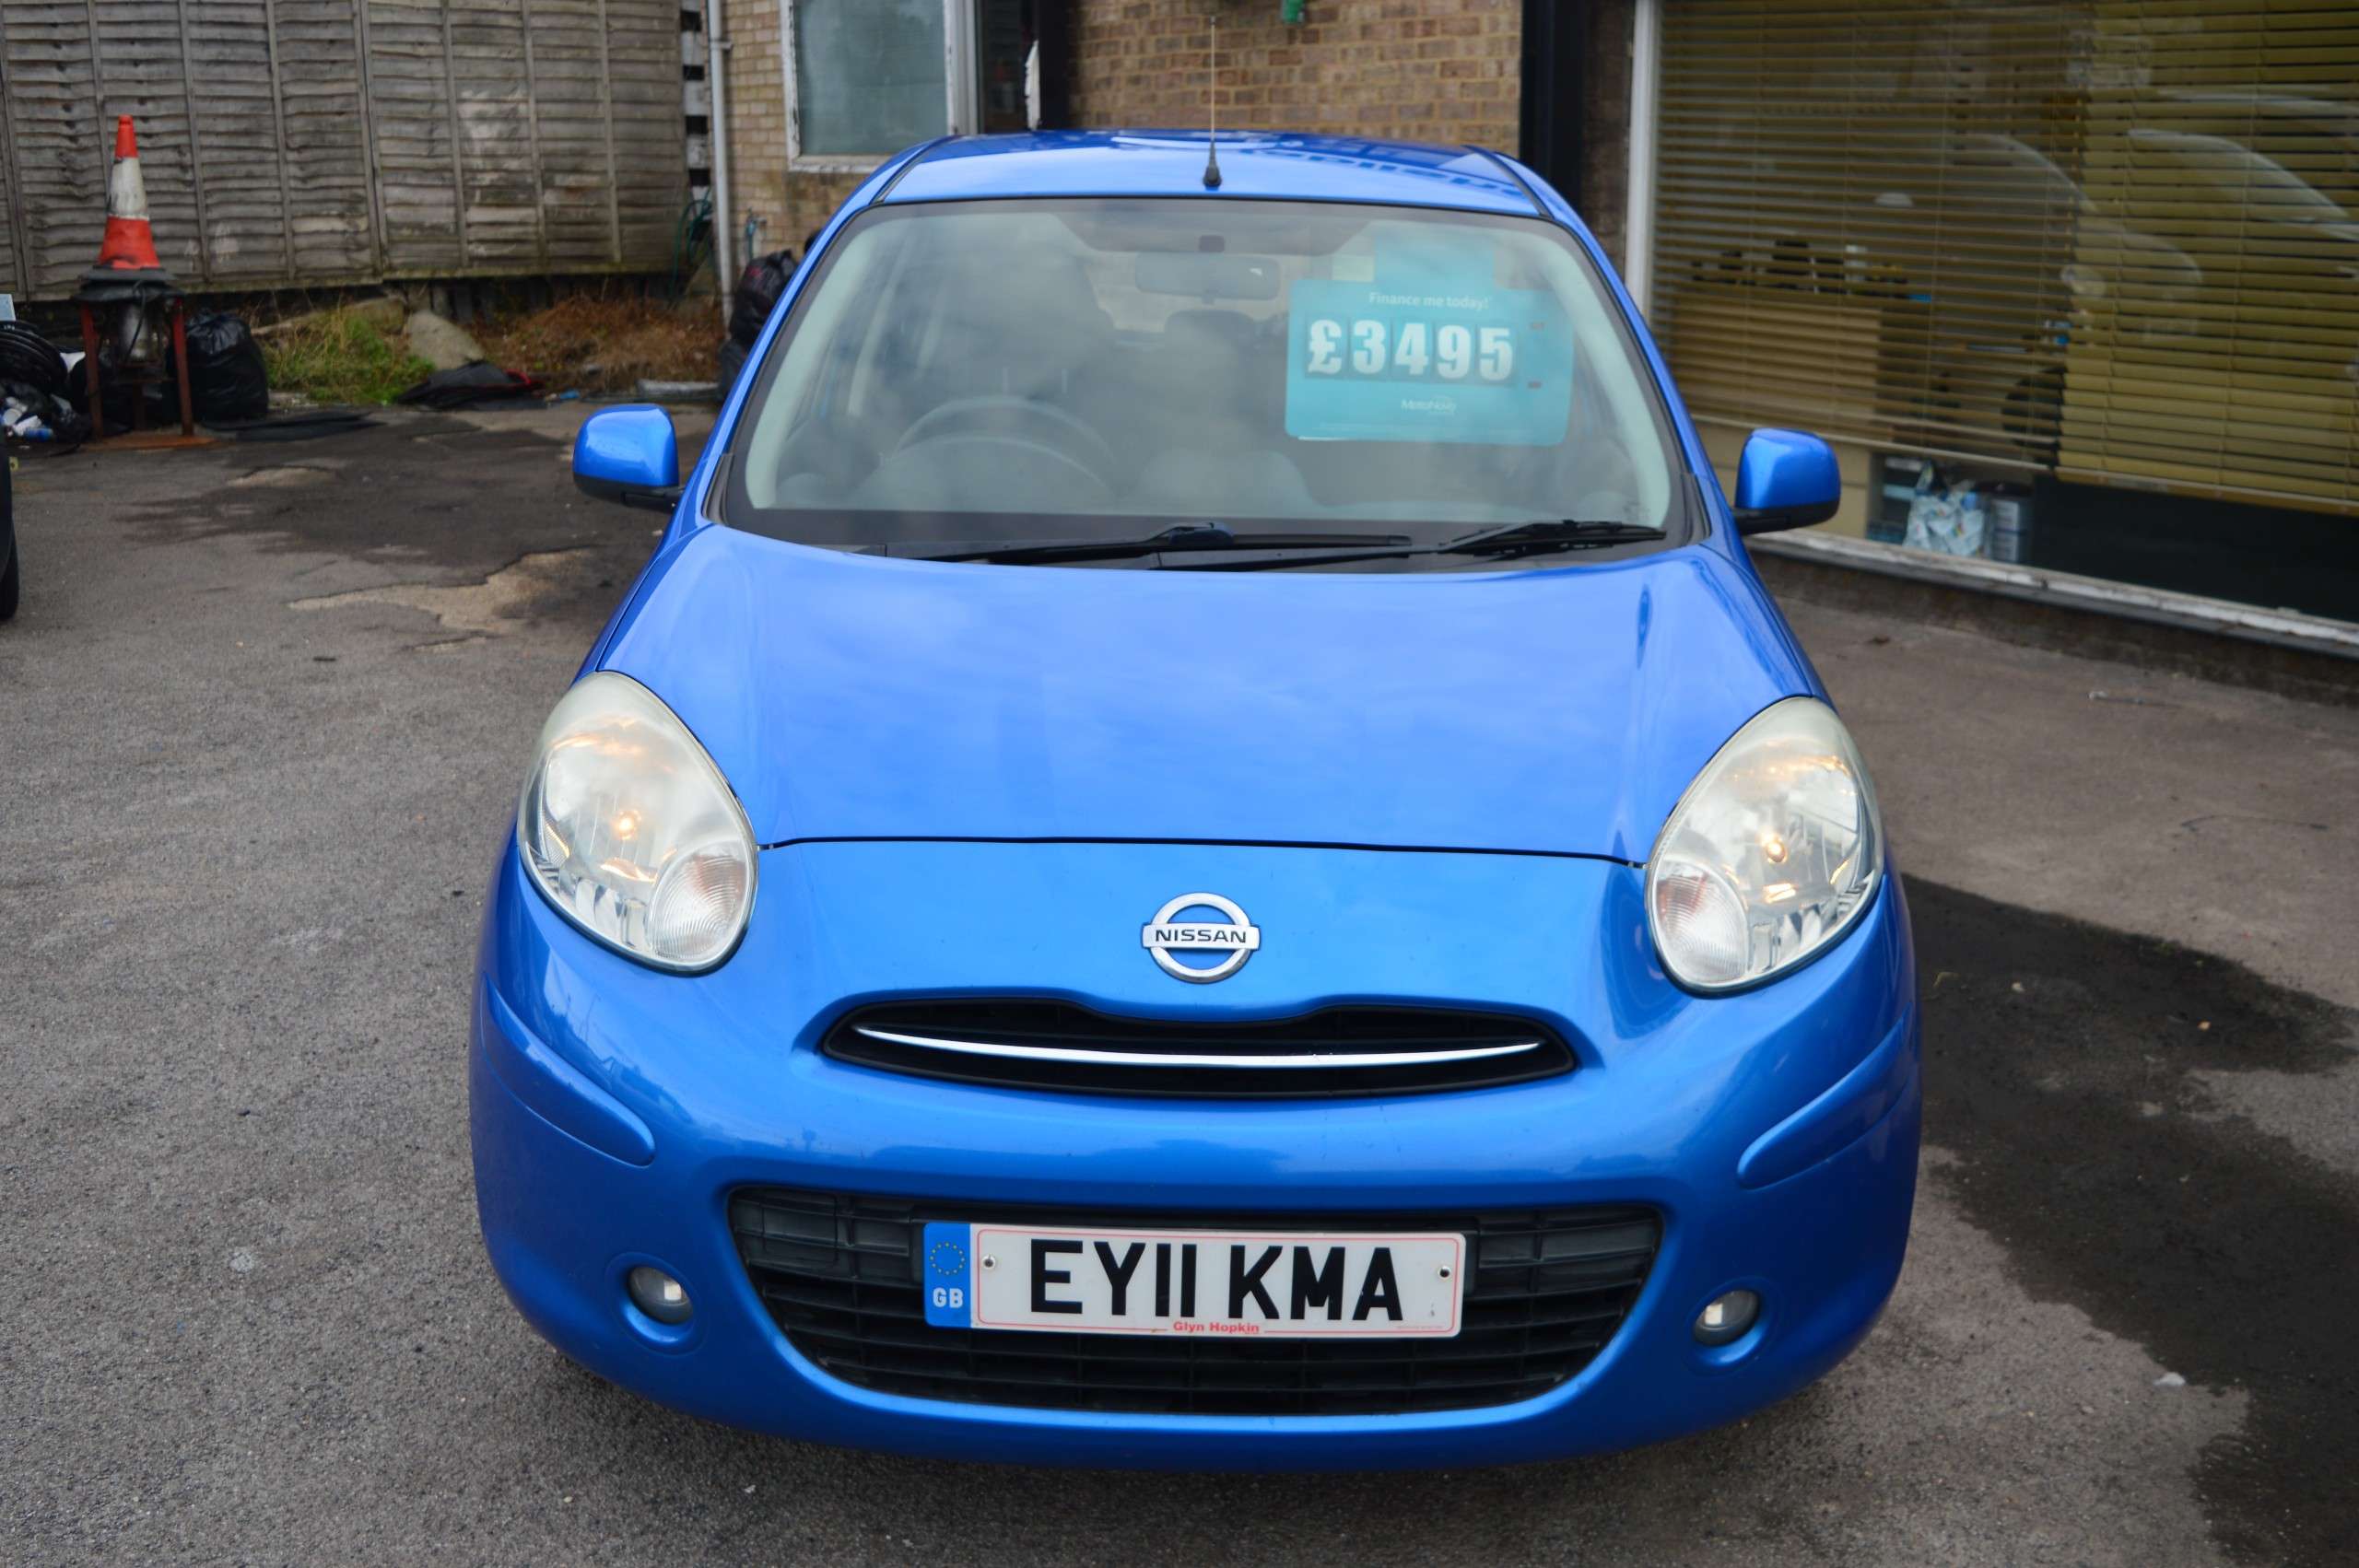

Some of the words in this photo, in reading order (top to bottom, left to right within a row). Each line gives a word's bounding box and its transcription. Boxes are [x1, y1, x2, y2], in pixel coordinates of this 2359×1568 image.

[1368, 291, 1420, 308] Finance
[1423, 295, 1443, 308] me
[1445, 294, 1490, 311] today!
[1307, 319, 1513, 380] £3495
[1155, 929, 1247, 943] NISSAN
[1030, 1238, 1197, 1317] EY11
[1228, 1244, 1403, 1321] KMA
[932, 1287, 964, 1308] GB
[1173, 1321, 1204, 1333] Glyn
[1209, 1322, 1260, 1335] Hopkin
